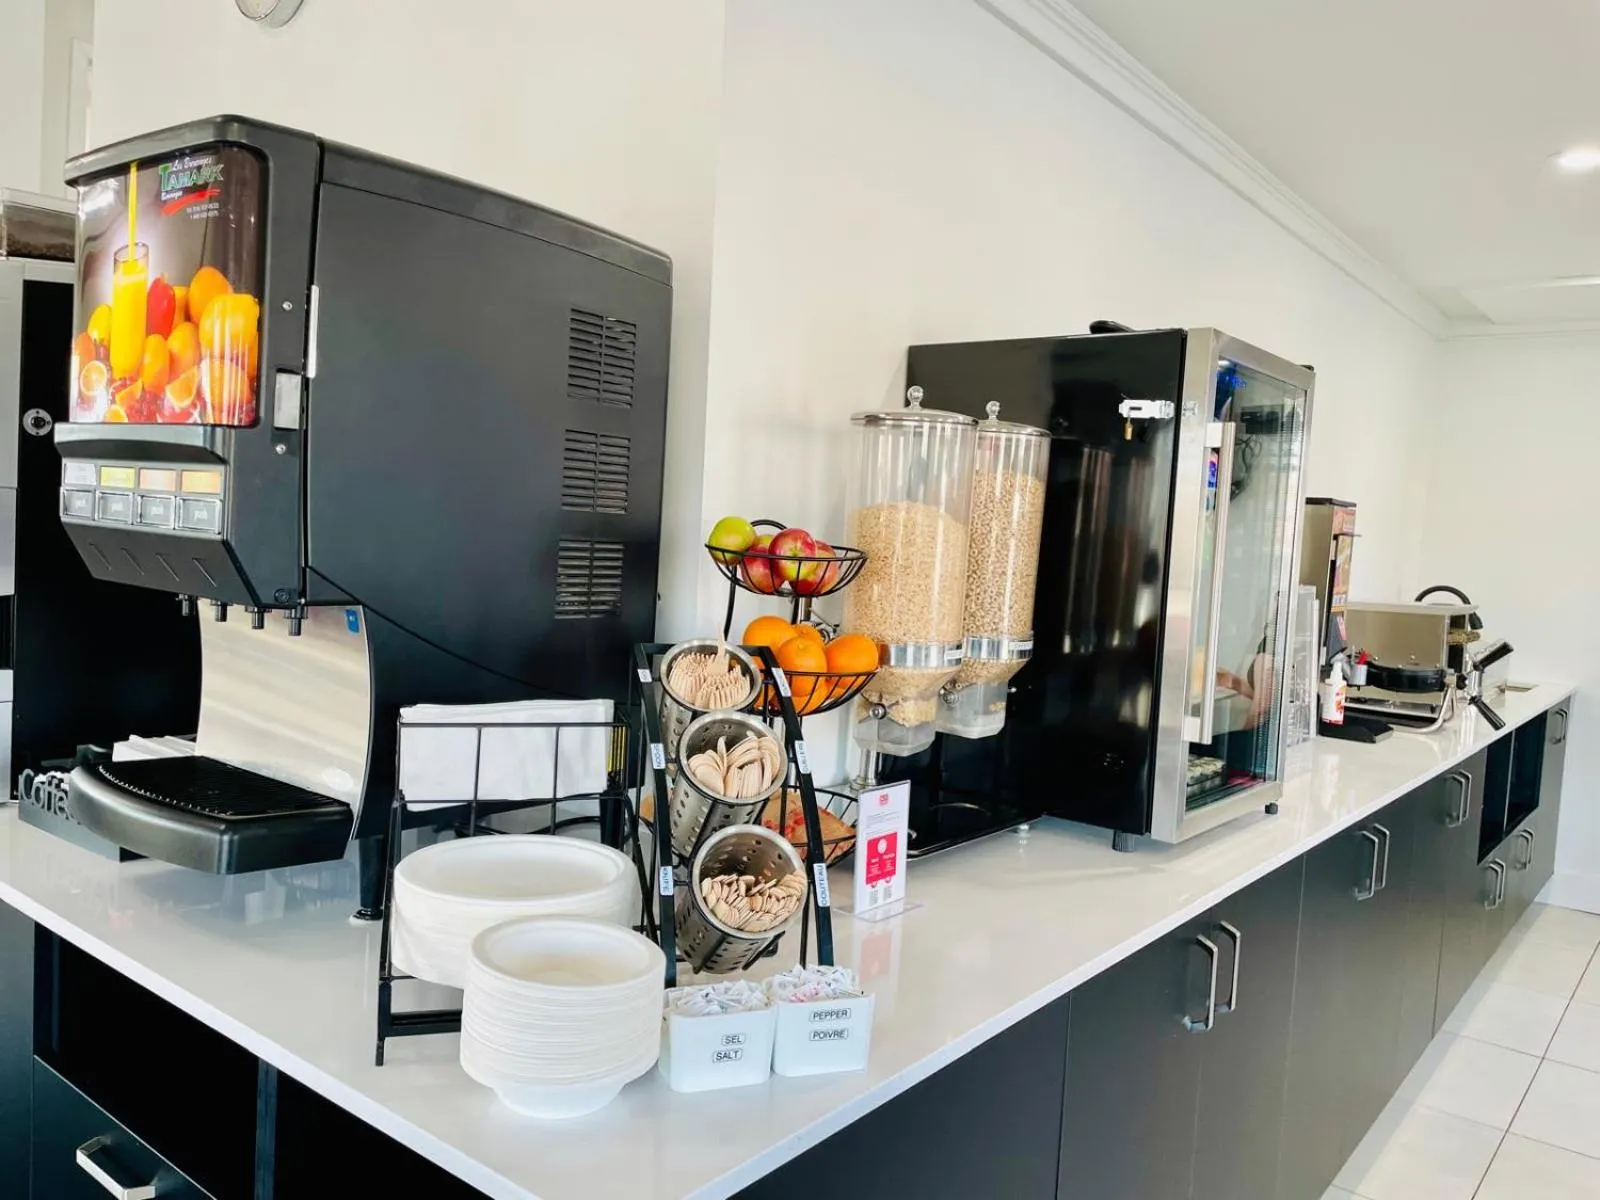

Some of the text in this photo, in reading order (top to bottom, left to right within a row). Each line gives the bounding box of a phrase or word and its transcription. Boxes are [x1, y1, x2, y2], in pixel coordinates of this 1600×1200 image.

[816, 864, 827, 906] COUTEAU
[813, 1009, 848, 1020] PEPPER
[725, 1035, 742, 1045] SEL
[812, 1029, 846, 1040] POIVRE
[716, 1050, 739, 1061] SALT
